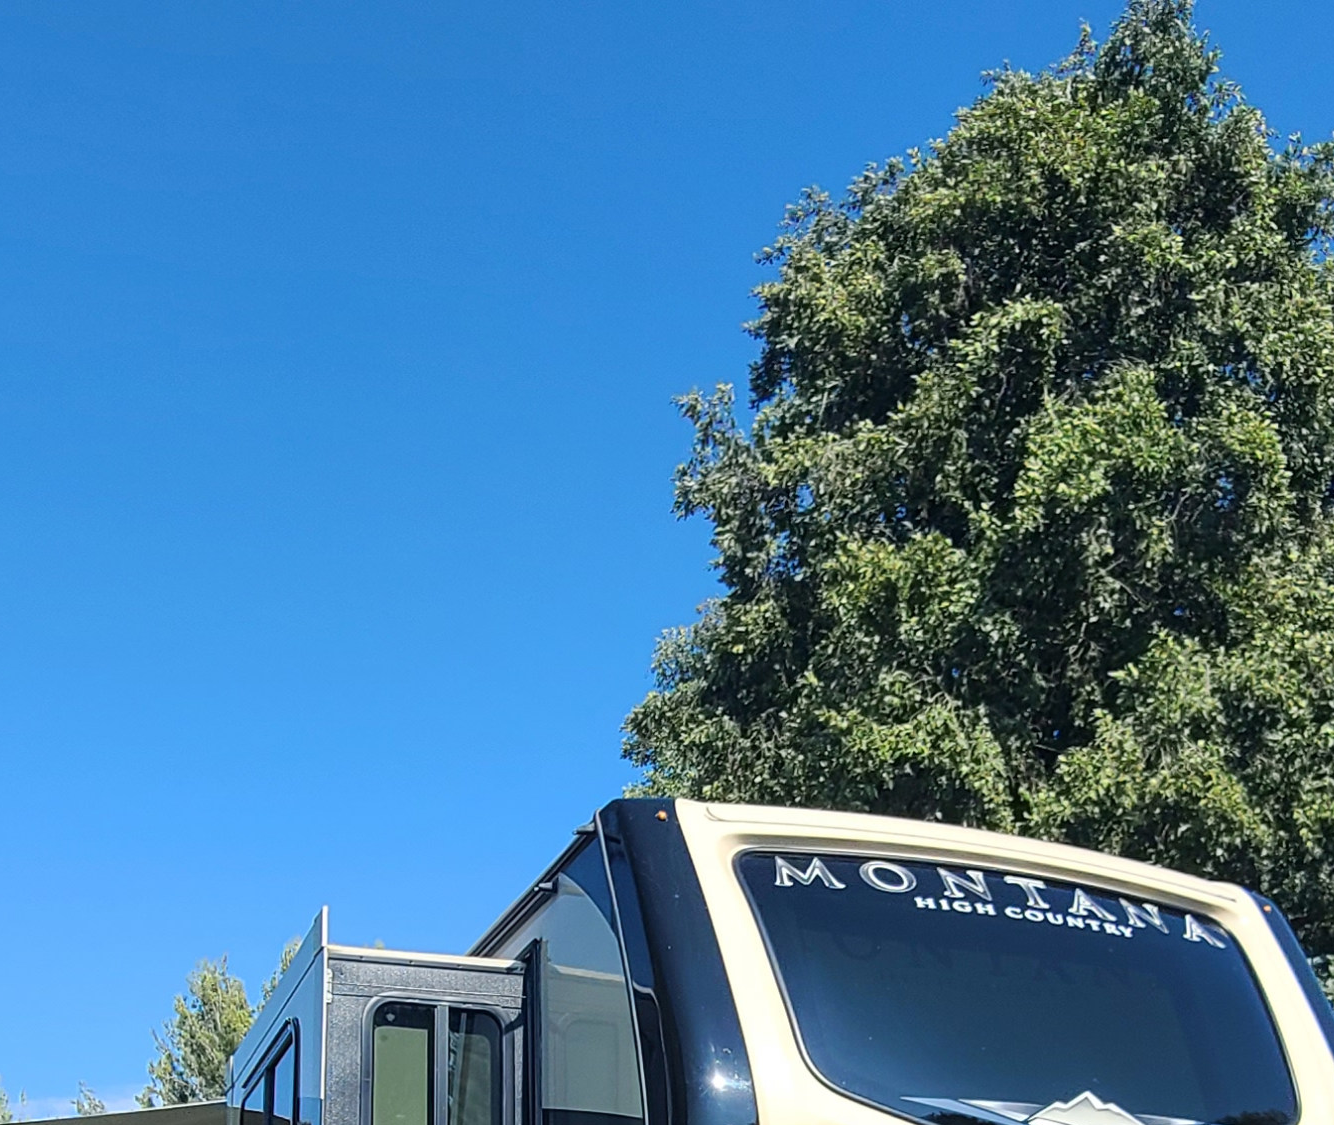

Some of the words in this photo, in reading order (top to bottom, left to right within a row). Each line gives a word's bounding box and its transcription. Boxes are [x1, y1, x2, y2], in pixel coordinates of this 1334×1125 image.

[774, 855, 1227, 949] MONTANA
[914, 896, 997, 916] HIGH
[1003, 906, 1134, 938] COUNTRY
